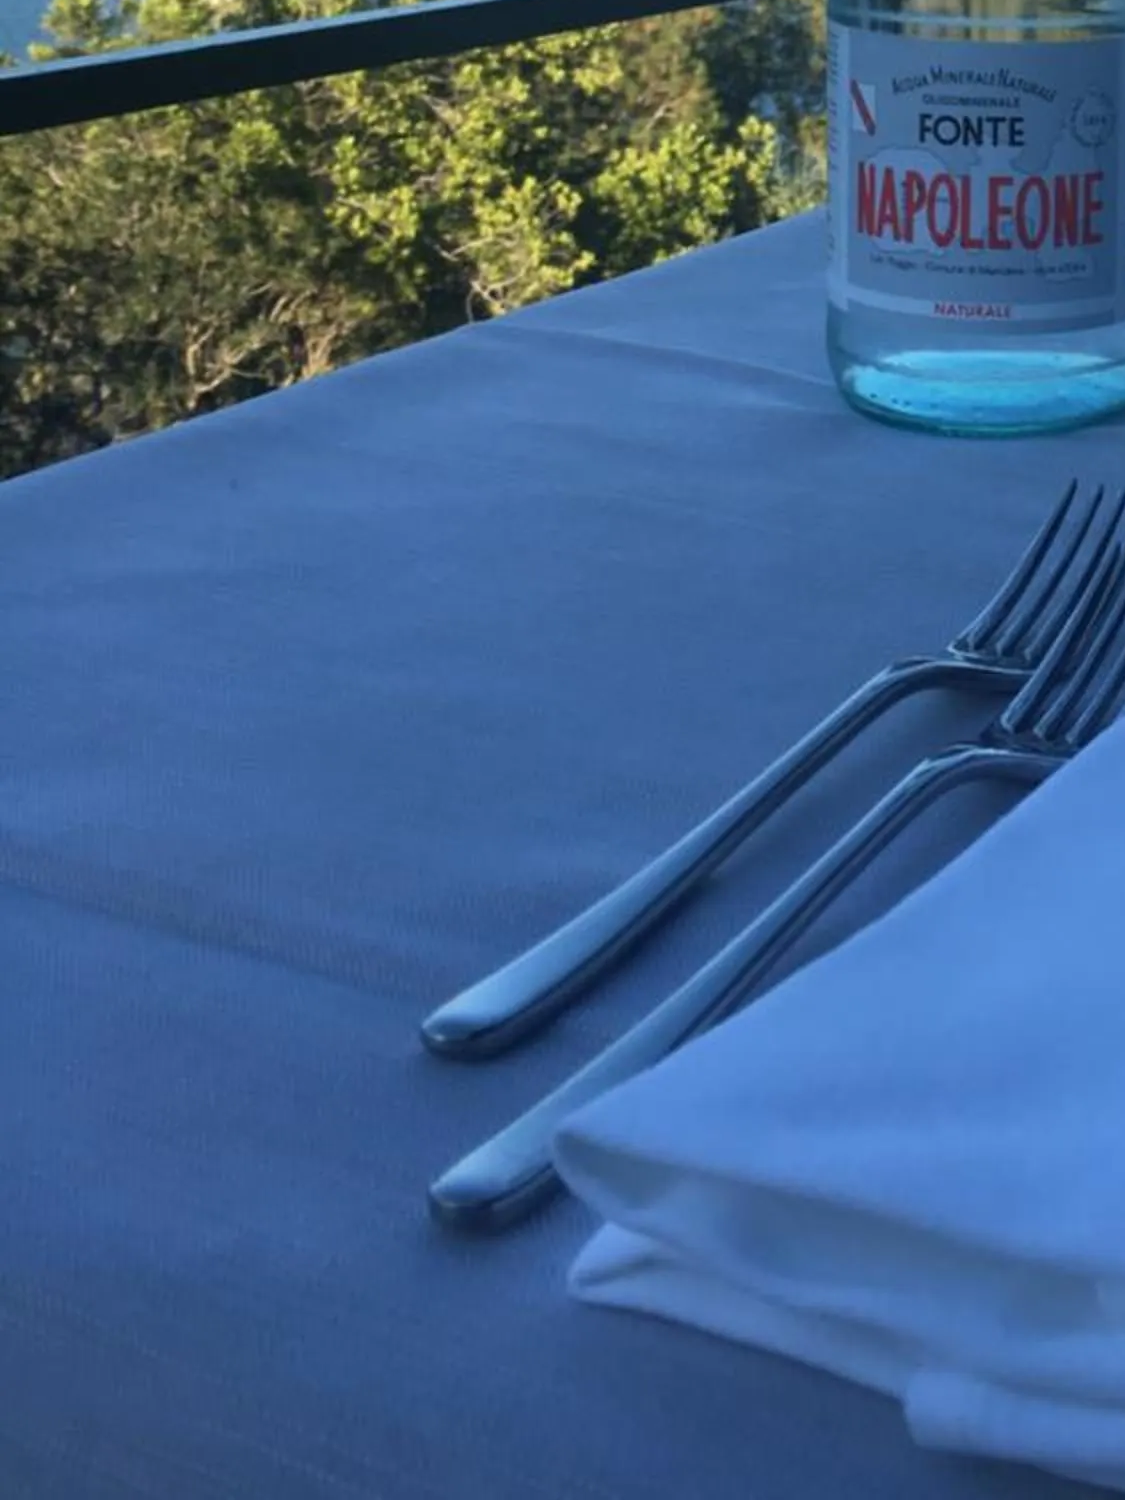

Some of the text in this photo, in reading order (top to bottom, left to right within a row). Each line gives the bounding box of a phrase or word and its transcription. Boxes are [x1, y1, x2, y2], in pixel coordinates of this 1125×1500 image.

[929, 63, 996, 86] MINERALE
[997, 67, 1058, 104] NATURALE
[918, 113, 1025, 147] FONTE
[857, 161, 1105, 251] NAPOLEONE
[933, 302, 1012, 320] NATURALE
